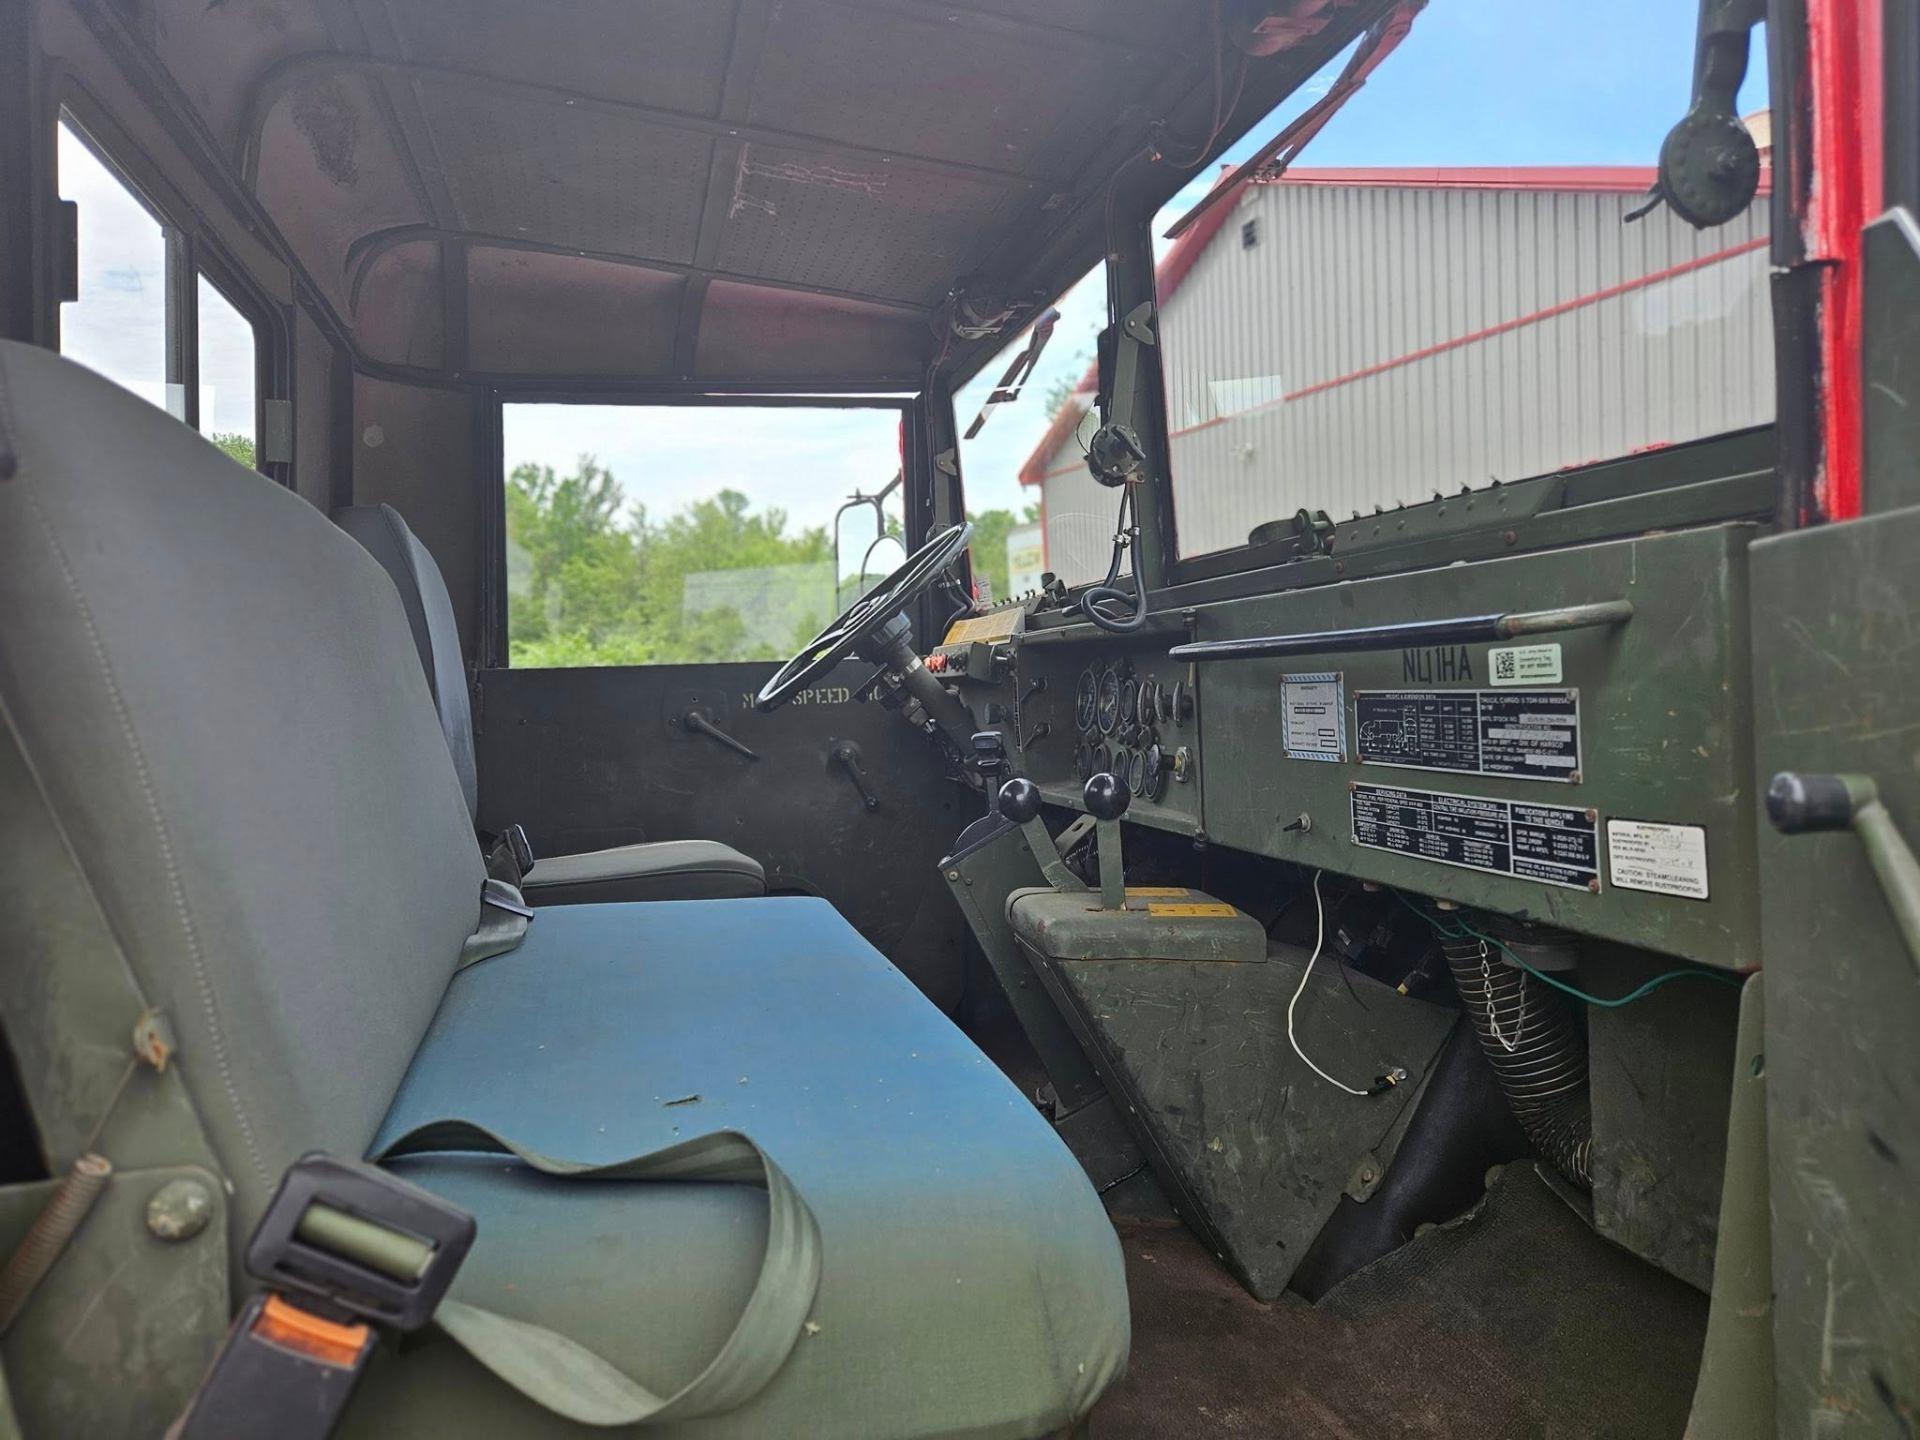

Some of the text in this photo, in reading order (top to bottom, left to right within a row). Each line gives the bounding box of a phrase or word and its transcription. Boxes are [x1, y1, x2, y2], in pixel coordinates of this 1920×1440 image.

[792, 687, 850, 705] SPEED
[1515, 807, 1549, 817] PUBLICATIONS
[1550, 811, 1574, 820] APPLYING
[1615, 876, 1703, 895] WILL REMOVE RUSTPROOFING
